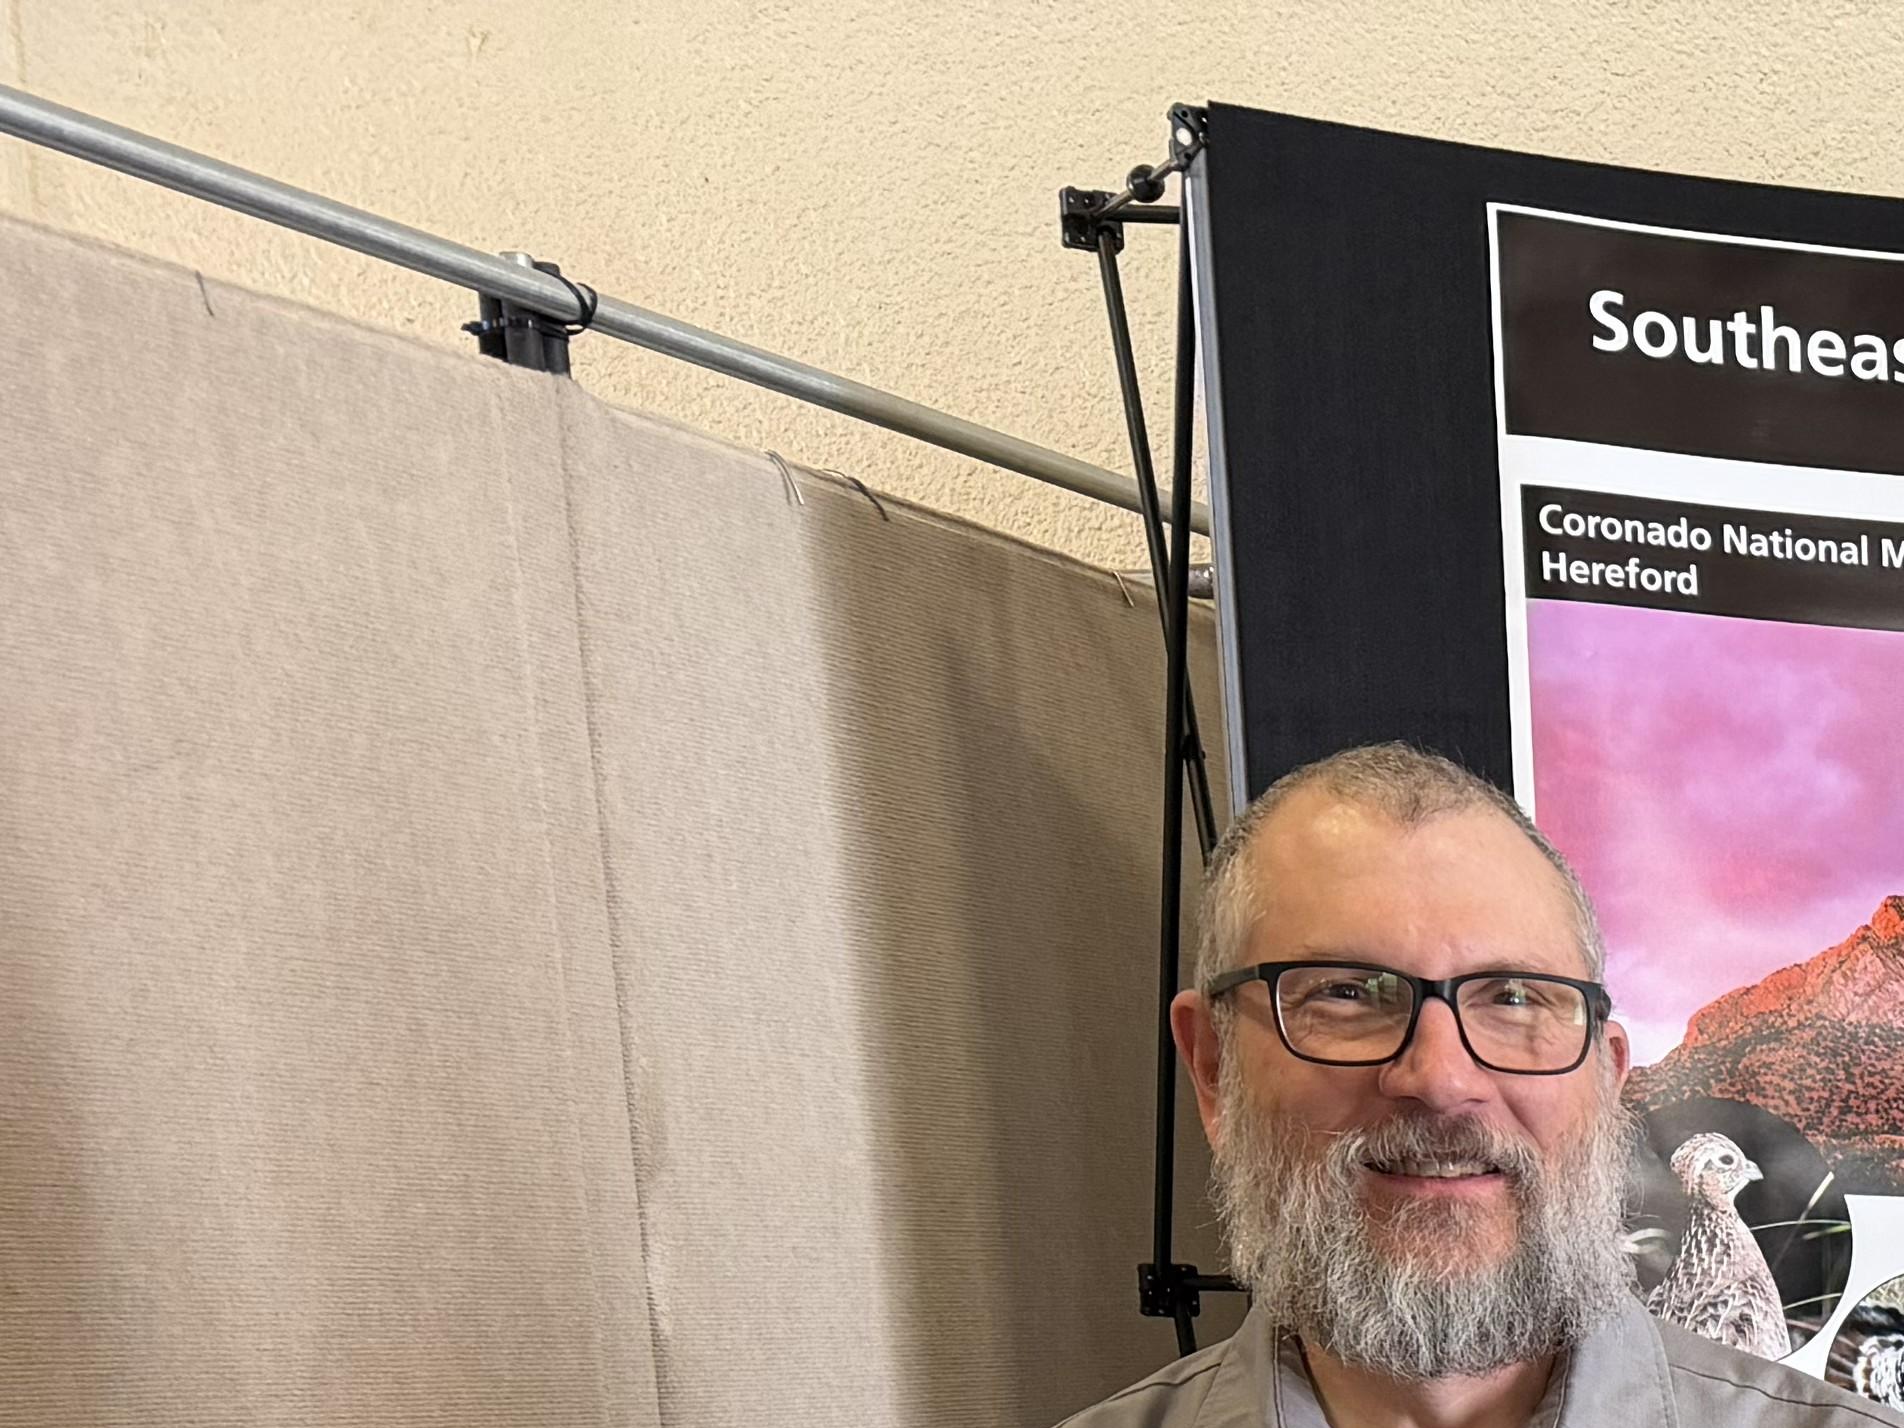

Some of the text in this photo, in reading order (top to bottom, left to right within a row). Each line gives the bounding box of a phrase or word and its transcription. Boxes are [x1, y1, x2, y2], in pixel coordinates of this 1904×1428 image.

[1537, 502, 1713, 555] Coronado
[1721, 522, 1871, 568] National
[1540, 549, 1700, 599] Hereford
